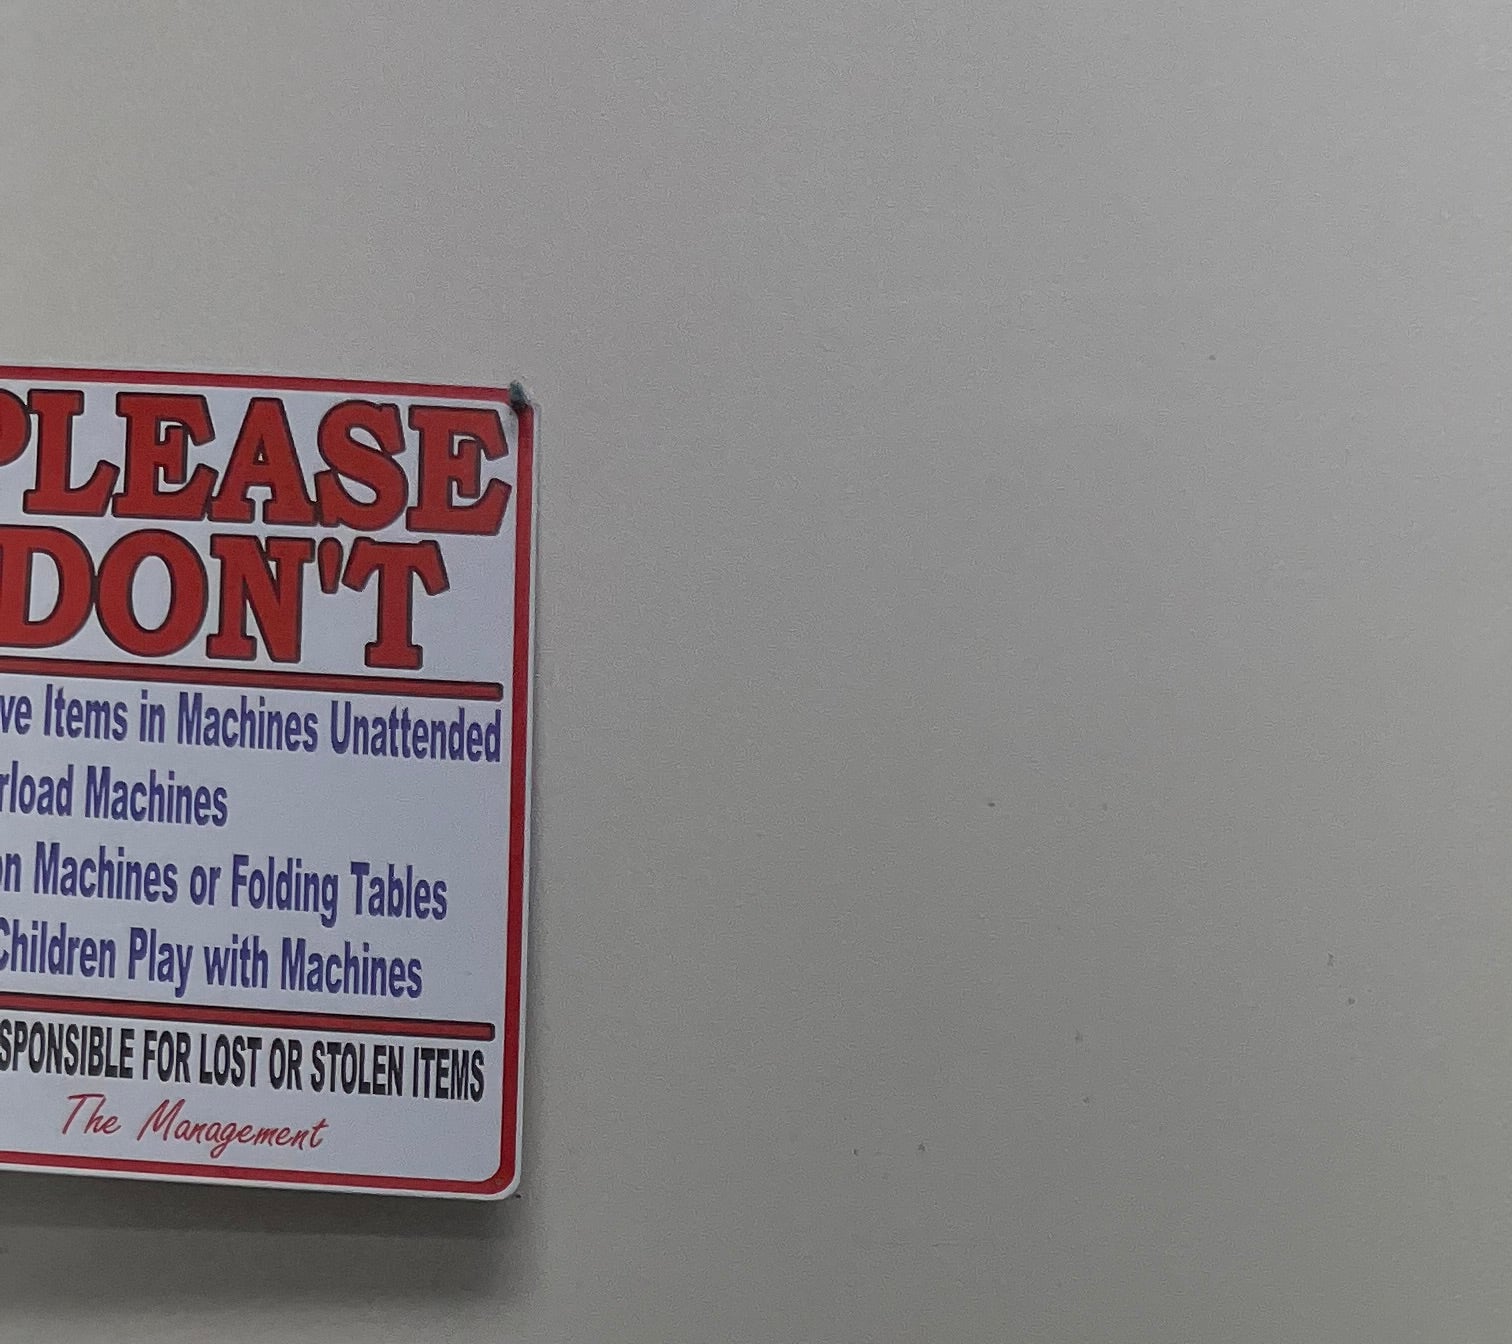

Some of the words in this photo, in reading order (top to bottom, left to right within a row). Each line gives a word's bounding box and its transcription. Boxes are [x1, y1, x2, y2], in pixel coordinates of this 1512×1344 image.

[0, 524, 450, 670] DON'T
[44, 683, 128, 741] Items
[139, 689, 165, 744] in
[177, 692, 319, 752] Machines
[330, 701, 501, 762] Unattended
[85, 765, 228, 827] Machines
[34, 841, 178, 904] Machines
[190, 871, 222, 908] or
[231, 854, 339, 928] Folding
[350, 861, 448, 921] Tables
[128, 927, 194, 998] Play
[204, 934, 269, 990] with
[281, 937, 424, 999] Machines
[0, 1018, 135, 1080] SPONSIBLE
[142, 1030, 192, 1083] FOR
[199, 1034, 262, 1090] LOST
[269, 1037, 302, 1090] OR
[310, 1041, 403, 1096] STOLEN
[411, 1047, 485, 1102] ITEMS
[62, 1093, 122, 1136] The
[137, 1099, 330, 1158] Management
